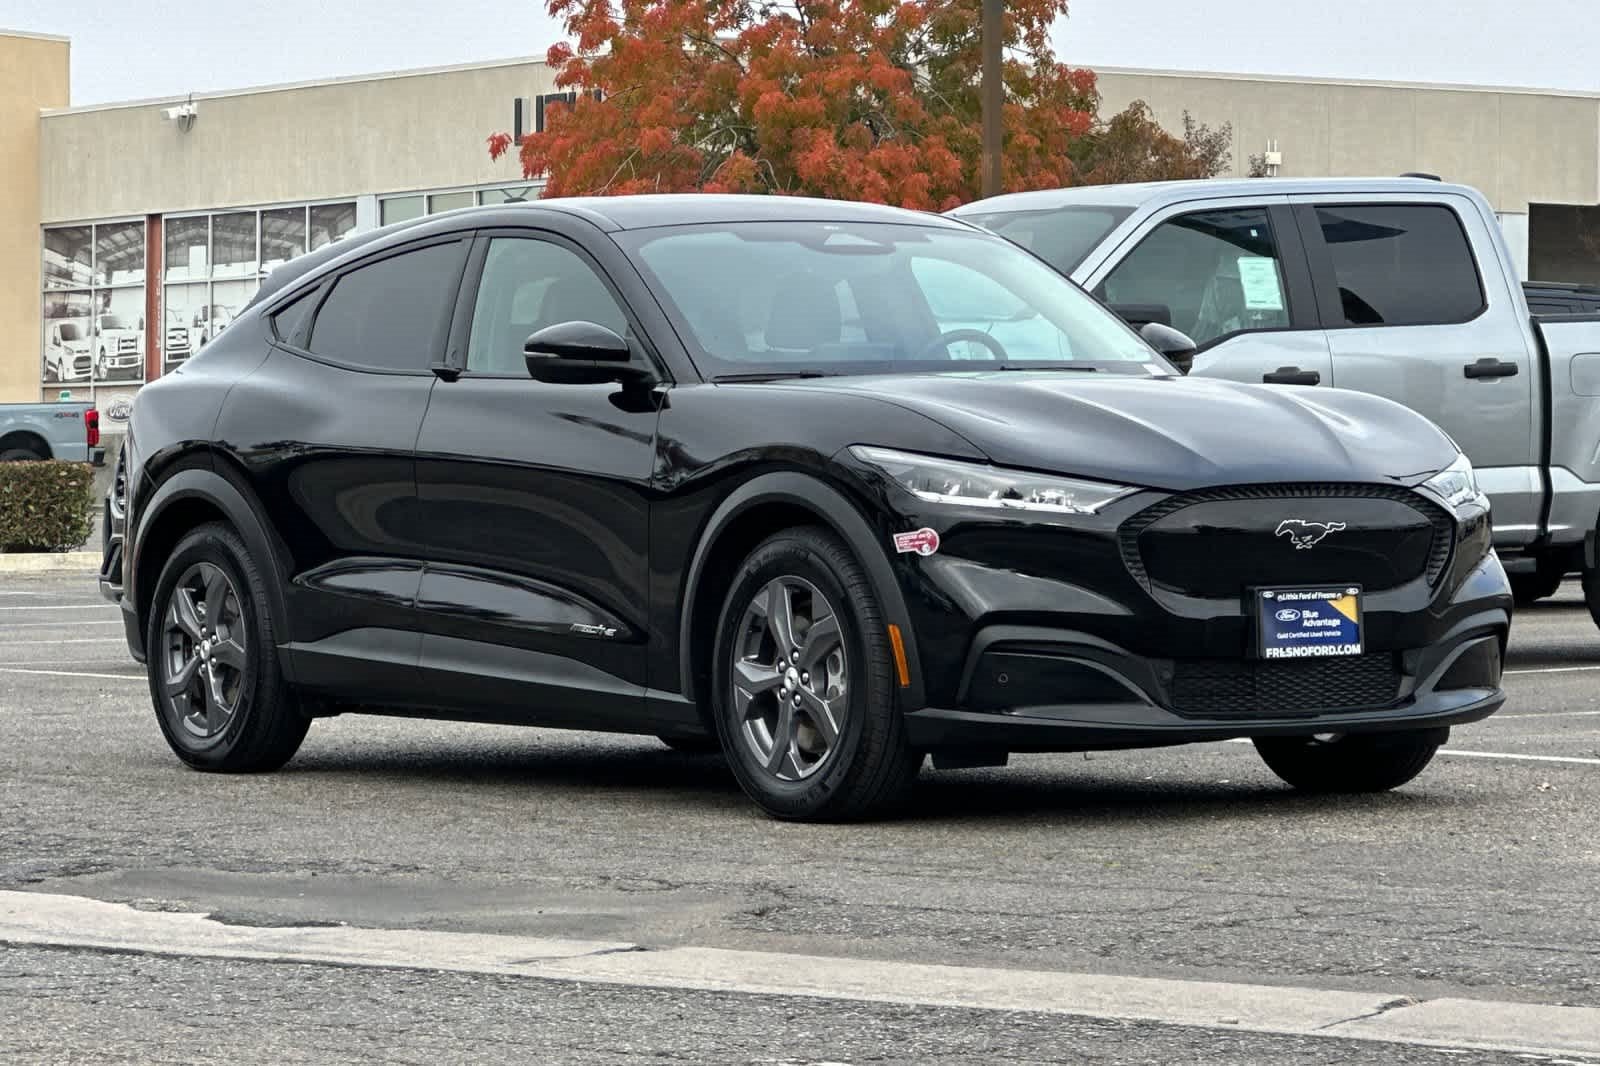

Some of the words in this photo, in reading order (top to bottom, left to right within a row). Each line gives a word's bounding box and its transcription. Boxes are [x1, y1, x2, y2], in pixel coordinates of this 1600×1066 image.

[1299, 592, 1311, 600] Ford
[1318, 592, 1336, 600] Fresno
[1302, 610, 1319, 618] Blue
[1303, 618, 1341, 627] Advantage
[1289, 631, 1309, 639] Certified
[1266, 644, 1361, 658] FRESNOFORD.COM
